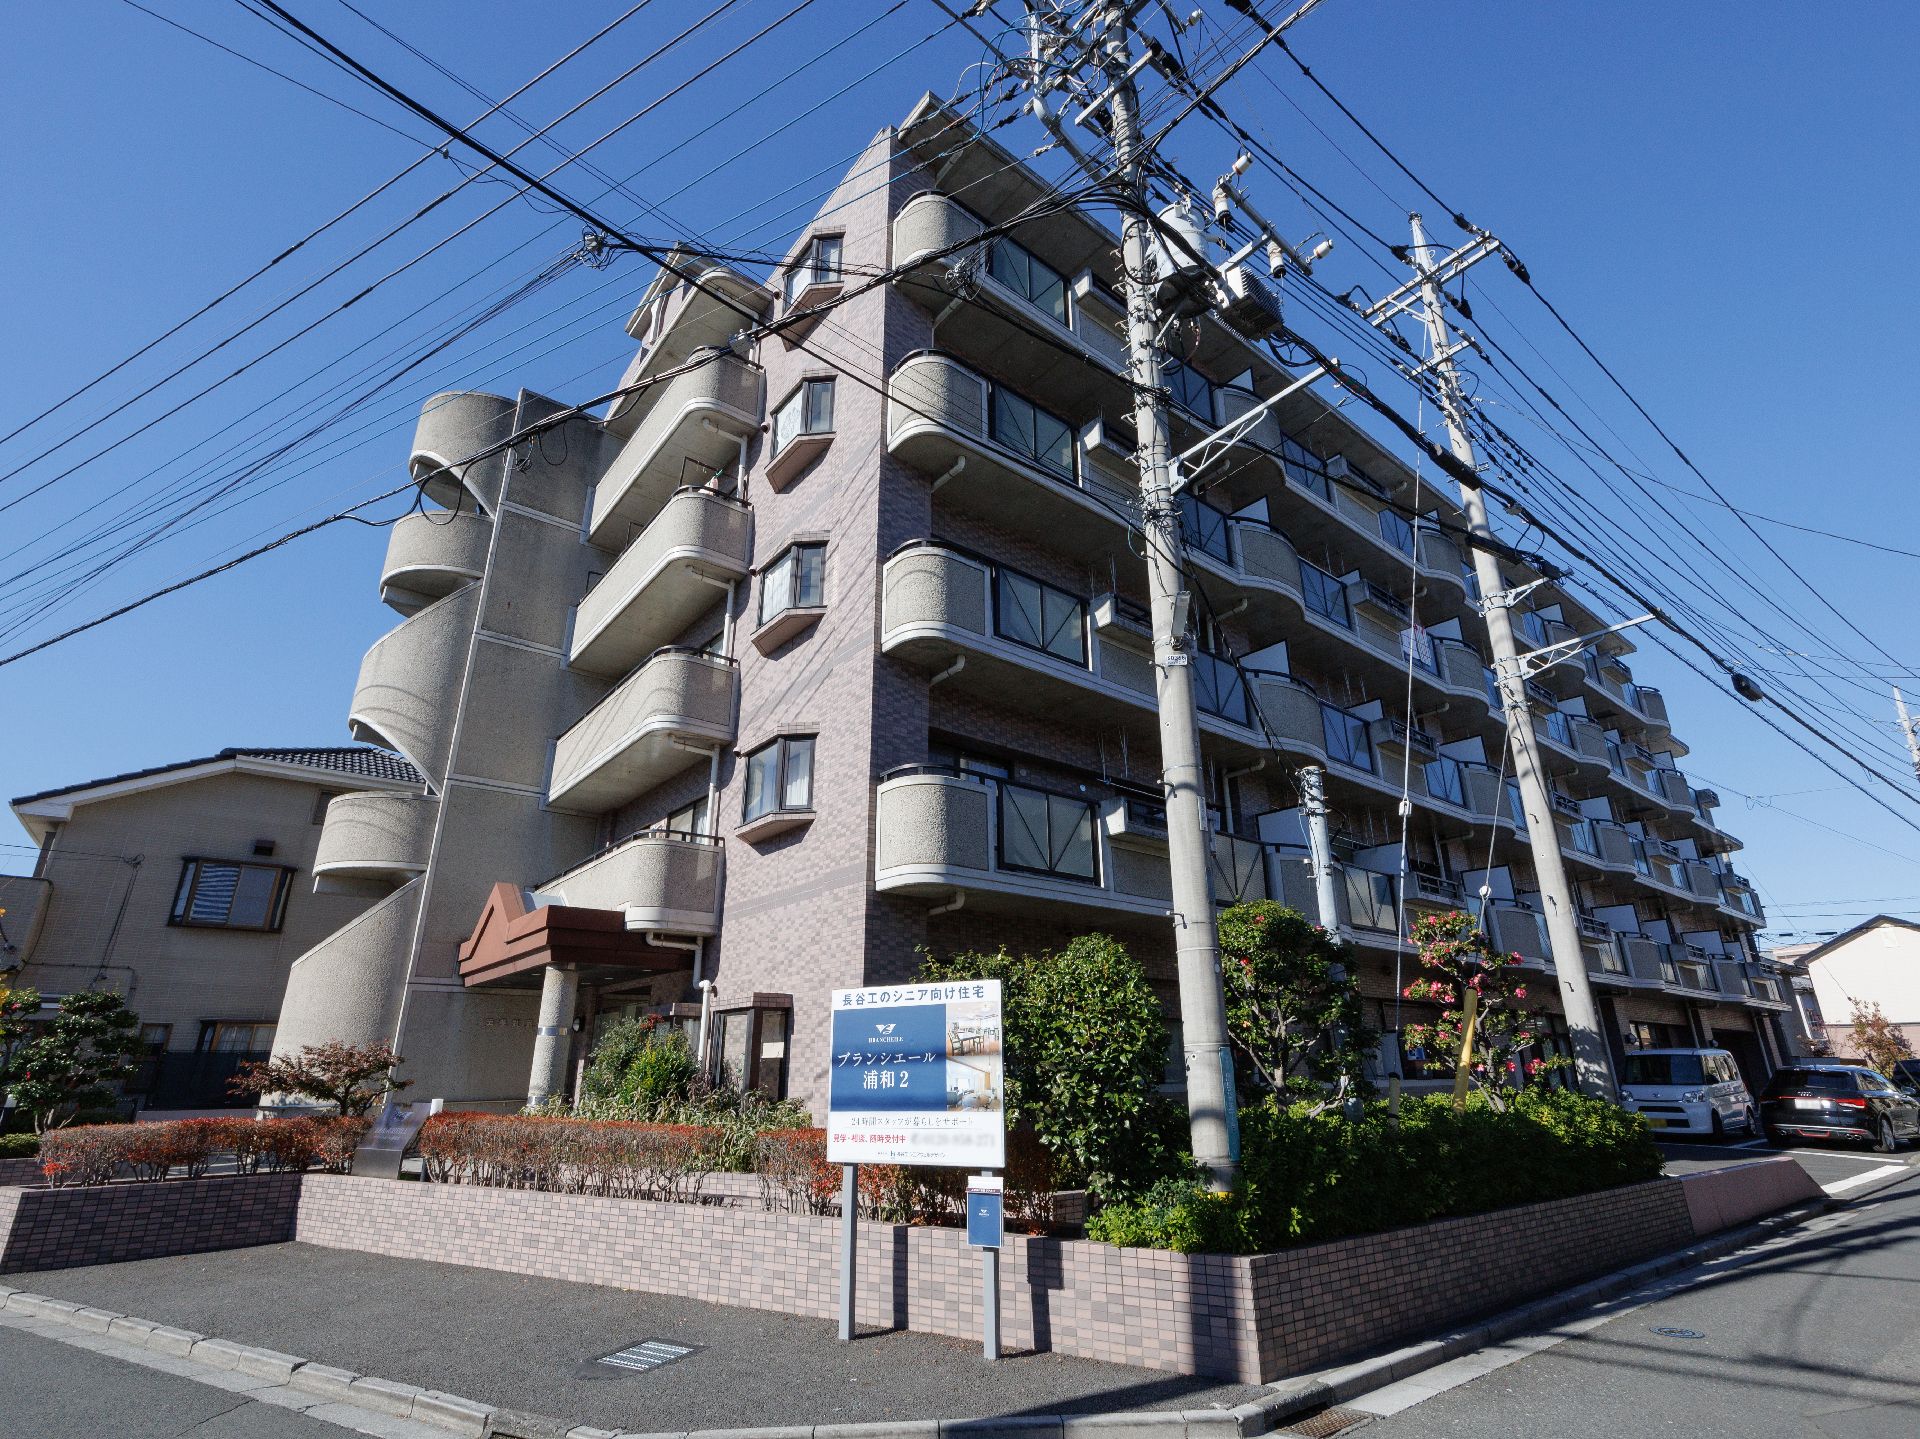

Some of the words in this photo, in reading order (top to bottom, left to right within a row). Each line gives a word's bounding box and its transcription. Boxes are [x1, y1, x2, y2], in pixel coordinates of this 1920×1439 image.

[842, 985, 984, 1007] 長谷工のシニア向け住宅
[837, 1052, 937, 1068] ブランシエール
